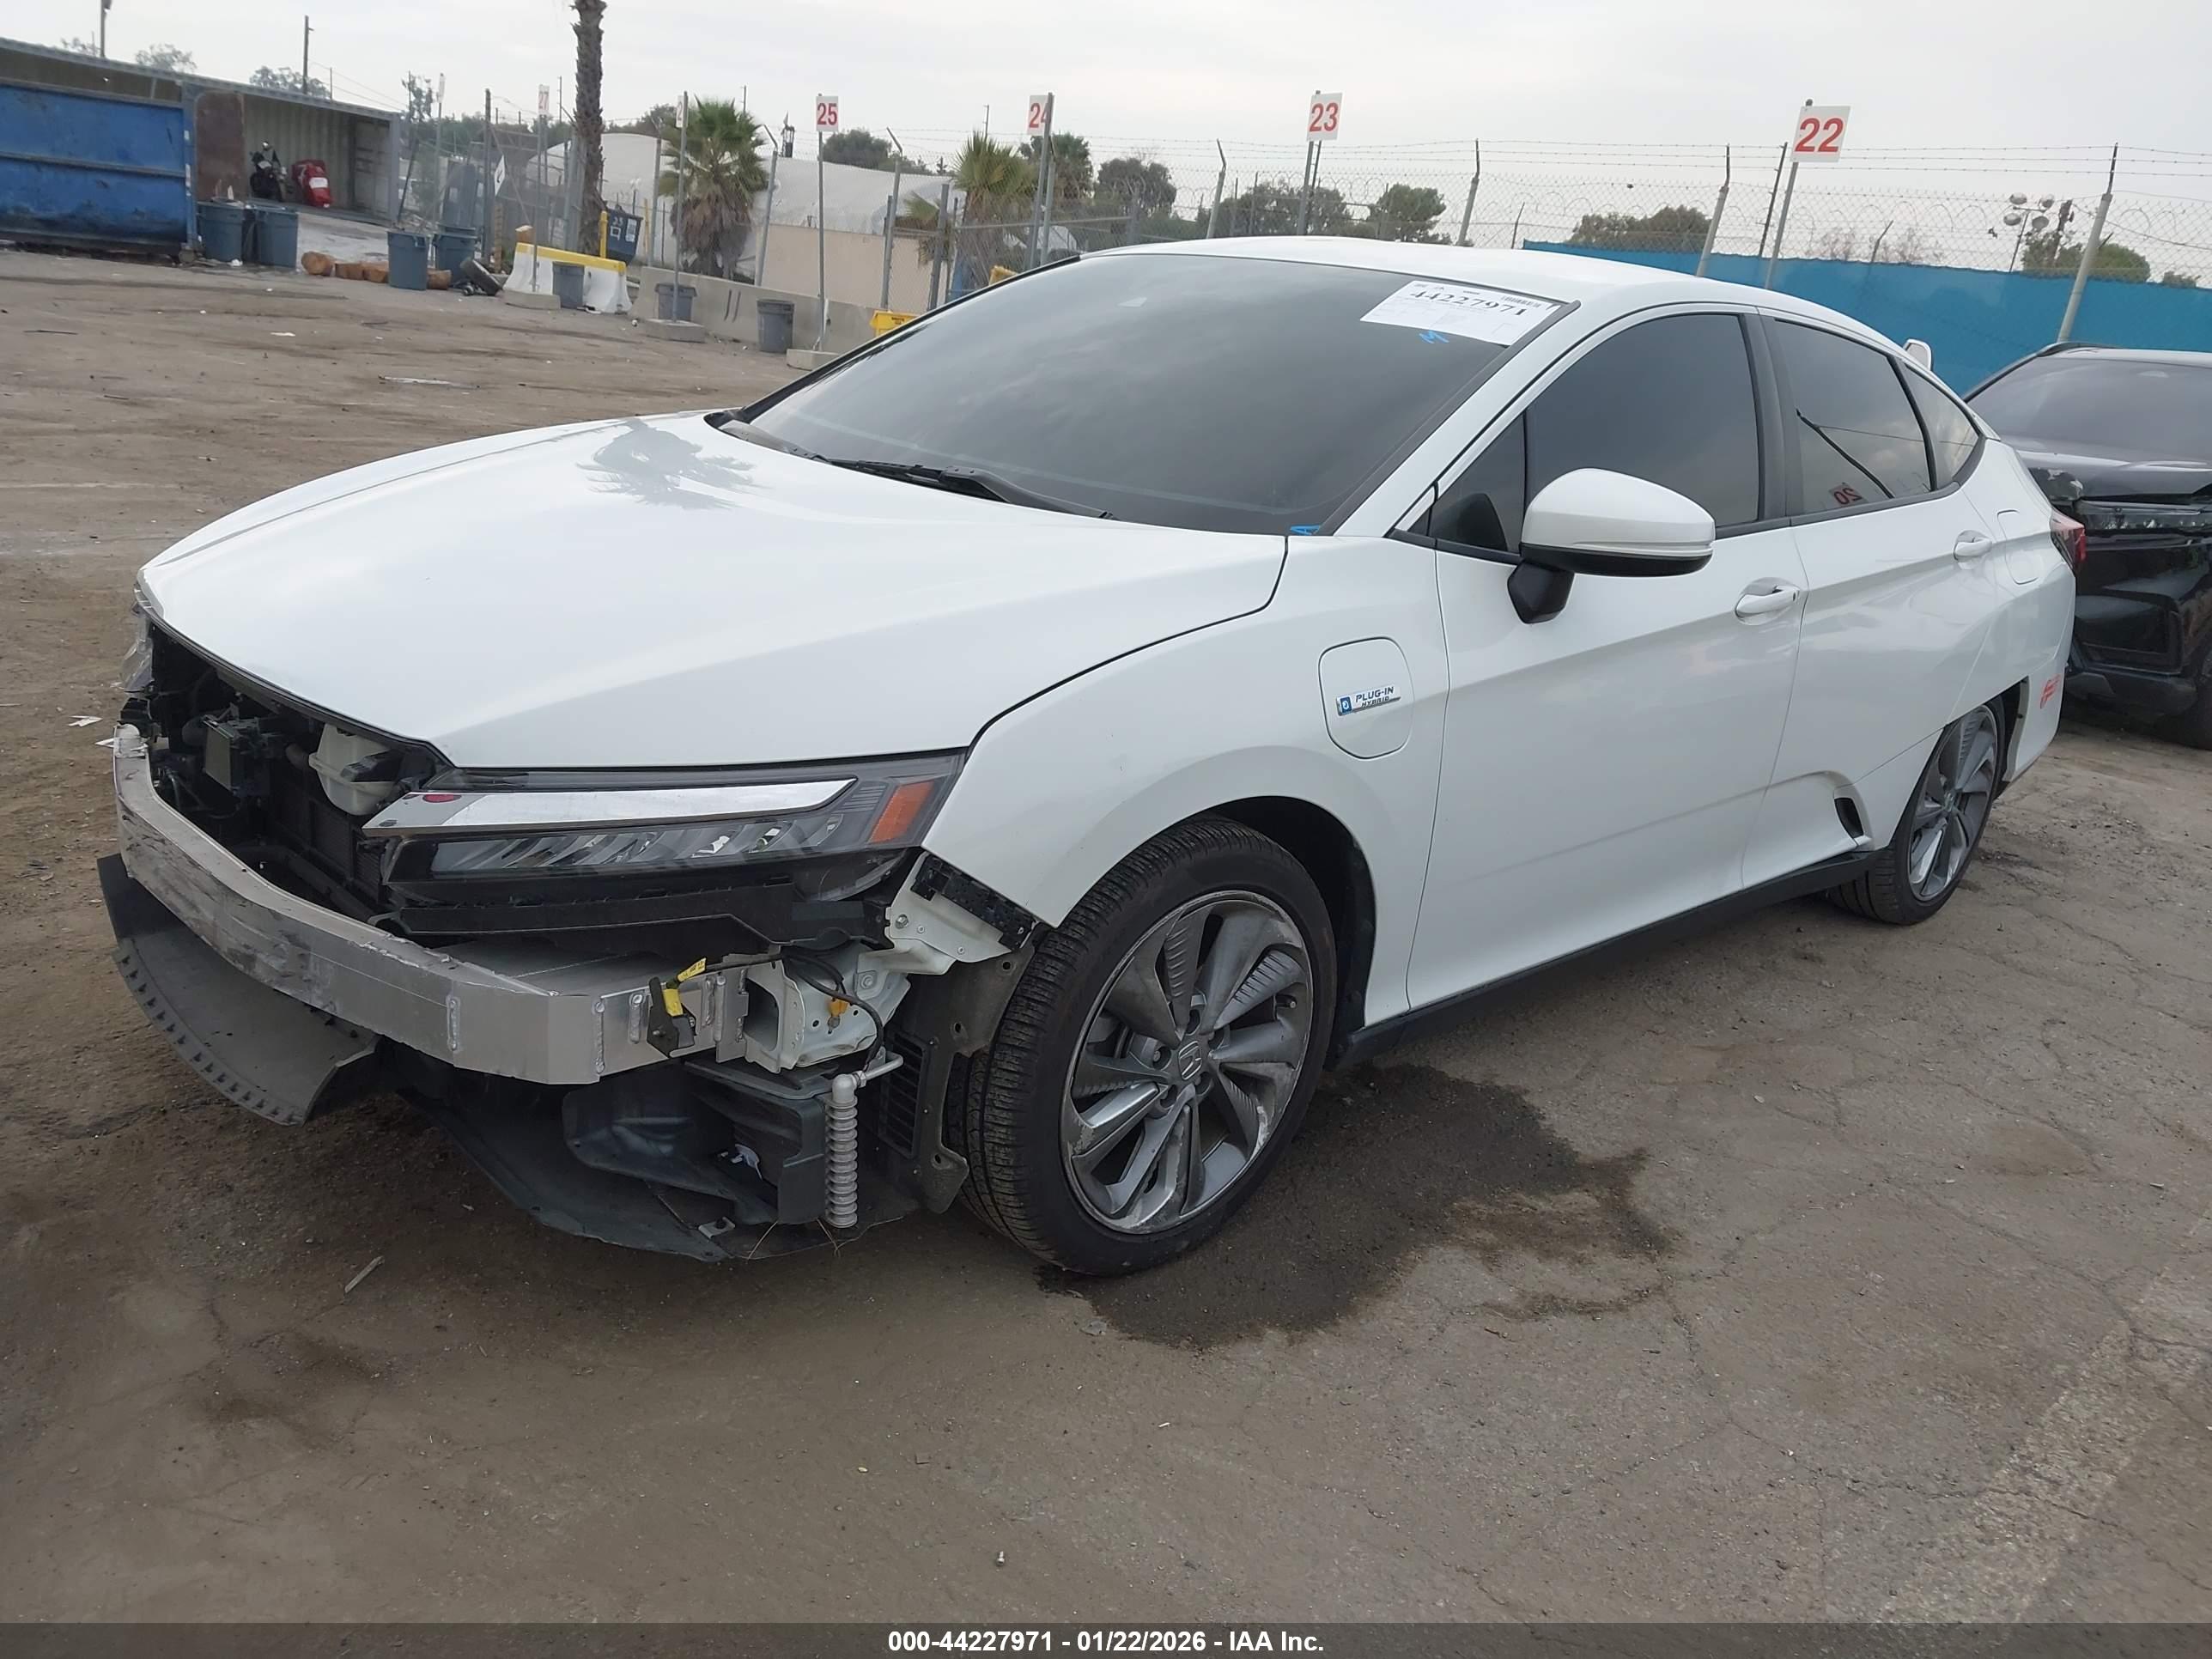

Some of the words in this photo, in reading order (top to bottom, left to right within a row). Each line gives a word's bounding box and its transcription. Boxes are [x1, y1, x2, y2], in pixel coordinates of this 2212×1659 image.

[817, 102, 838, 125] 25
[1309, 102, 1339, 132] 23
[1794, 117, 1844, 153] 22
[1410, 290, 1528, 316] 44227971
[1355, 686, 1395, 703] PLUG-IN
[1361, 696, 1390, 708] HYBRID
